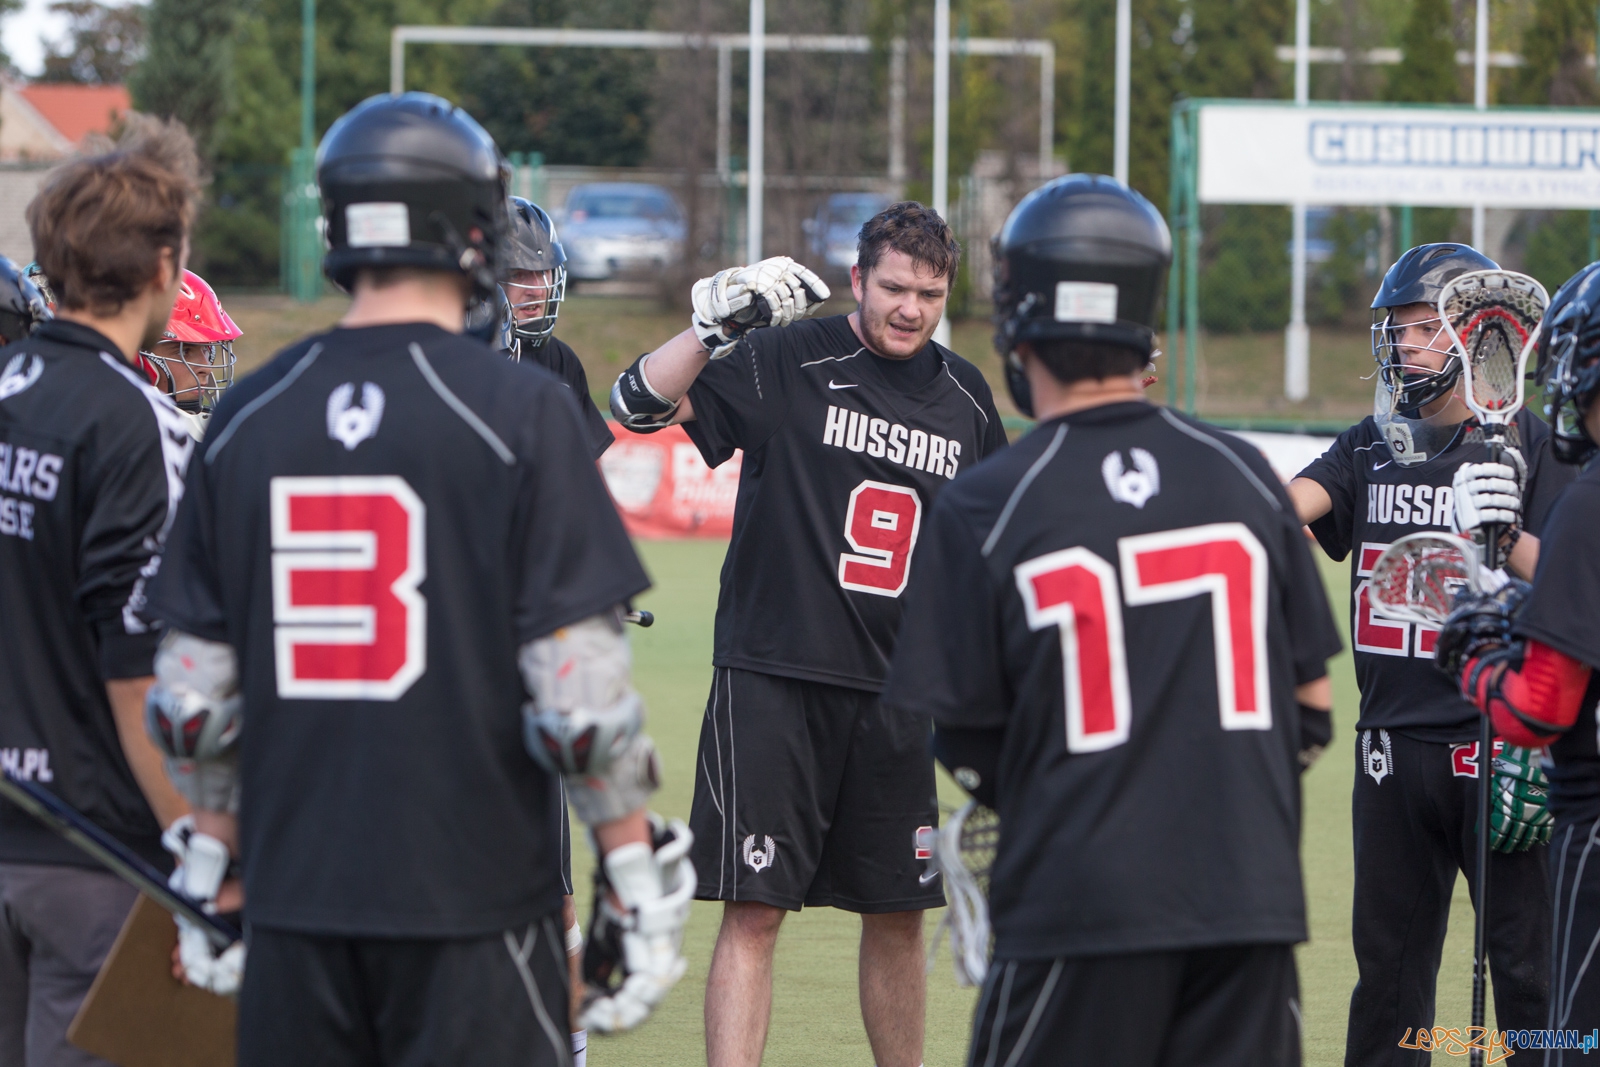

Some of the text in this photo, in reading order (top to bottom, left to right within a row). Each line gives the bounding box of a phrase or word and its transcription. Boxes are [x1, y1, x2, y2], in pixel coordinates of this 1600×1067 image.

[822, 405, 962, 480] HUSSARS
[0, 496, 35, 541] SE
[838, 479, 922, 598] 9
[1367, 484, 1453, 526] HUSSA
[270, 475, 427, 701] 3
[1013, 522, 1272, 754] 17
